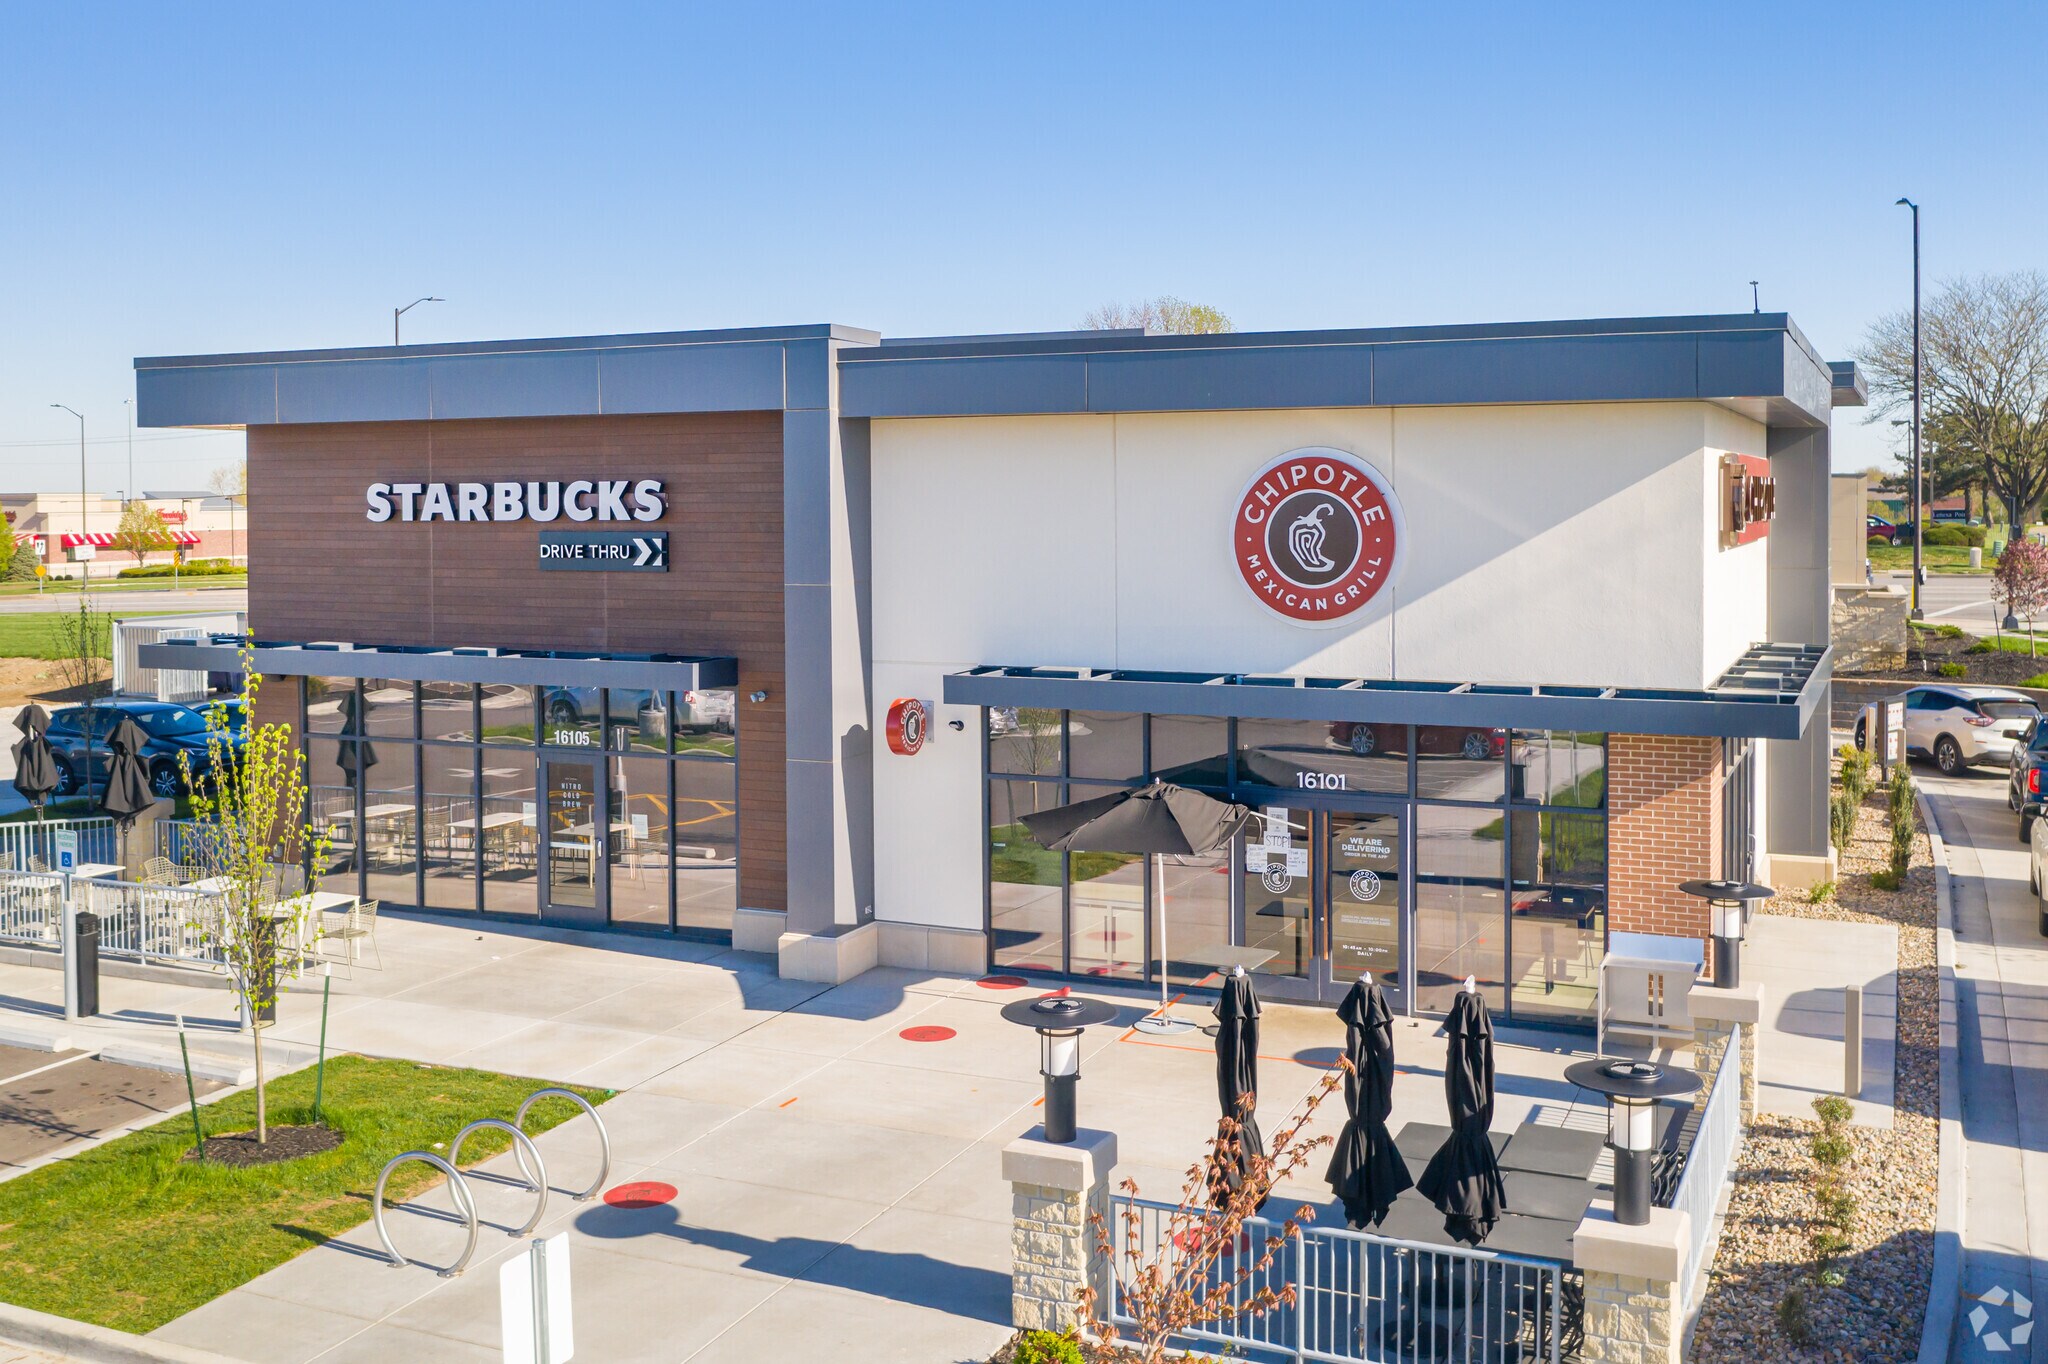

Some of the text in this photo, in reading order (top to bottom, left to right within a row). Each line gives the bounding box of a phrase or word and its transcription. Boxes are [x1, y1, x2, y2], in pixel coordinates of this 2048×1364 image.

[366, 479, 666, 523] STARBUCKS
[1244, 464, 1386, 526] CHIPOTLE
[540, 544, 630, 560] DRIVE THRU
[1247, 554, 1382, 610] MEXICAN GRILL
[901, 701, 926, 724] CHIPOTLE
[554, 730, 590, 745] 16105
[561, 783, 582, 791] NITRO
[1297, 772, 1346, 790] 16101
[562, 791, 580, 799] COLD
[562, 800, 581, 808] BREW
[1341, 844, 1391, 854] DELIVERING
[1350, 837, 1382, 846] WE ARE
[1352, 872, 1378, 884] CHIPOTLE
